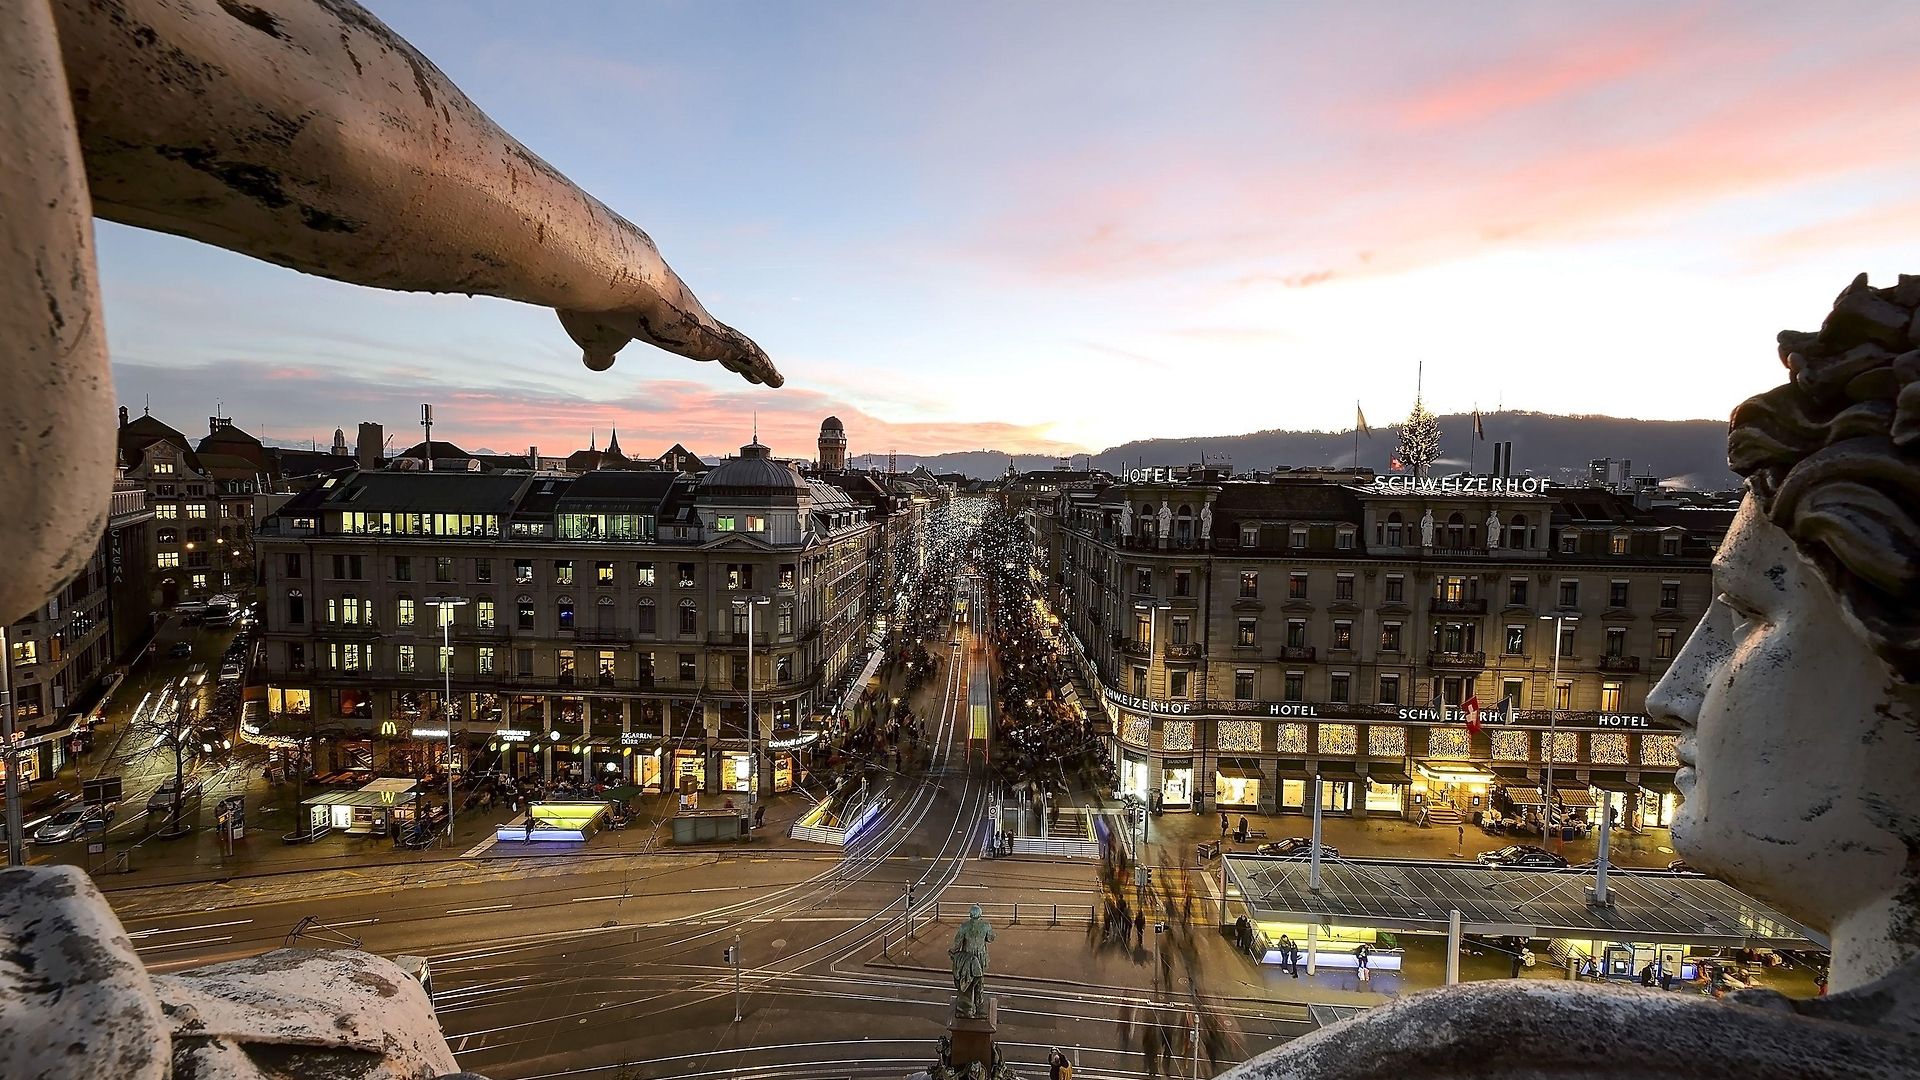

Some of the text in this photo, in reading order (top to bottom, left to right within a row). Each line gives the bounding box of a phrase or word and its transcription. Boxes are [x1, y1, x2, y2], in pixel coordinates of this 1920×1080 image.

[1123, 468, 1179, 483] HOTEL
[1374, 475, 1551, 493] SCHWEIZERHOF
[111, 529, 123, 583] CINEMA
[1270, 704, 1318, 716] HOTEL
[1599, 715, 1649, 727] HOTEL
